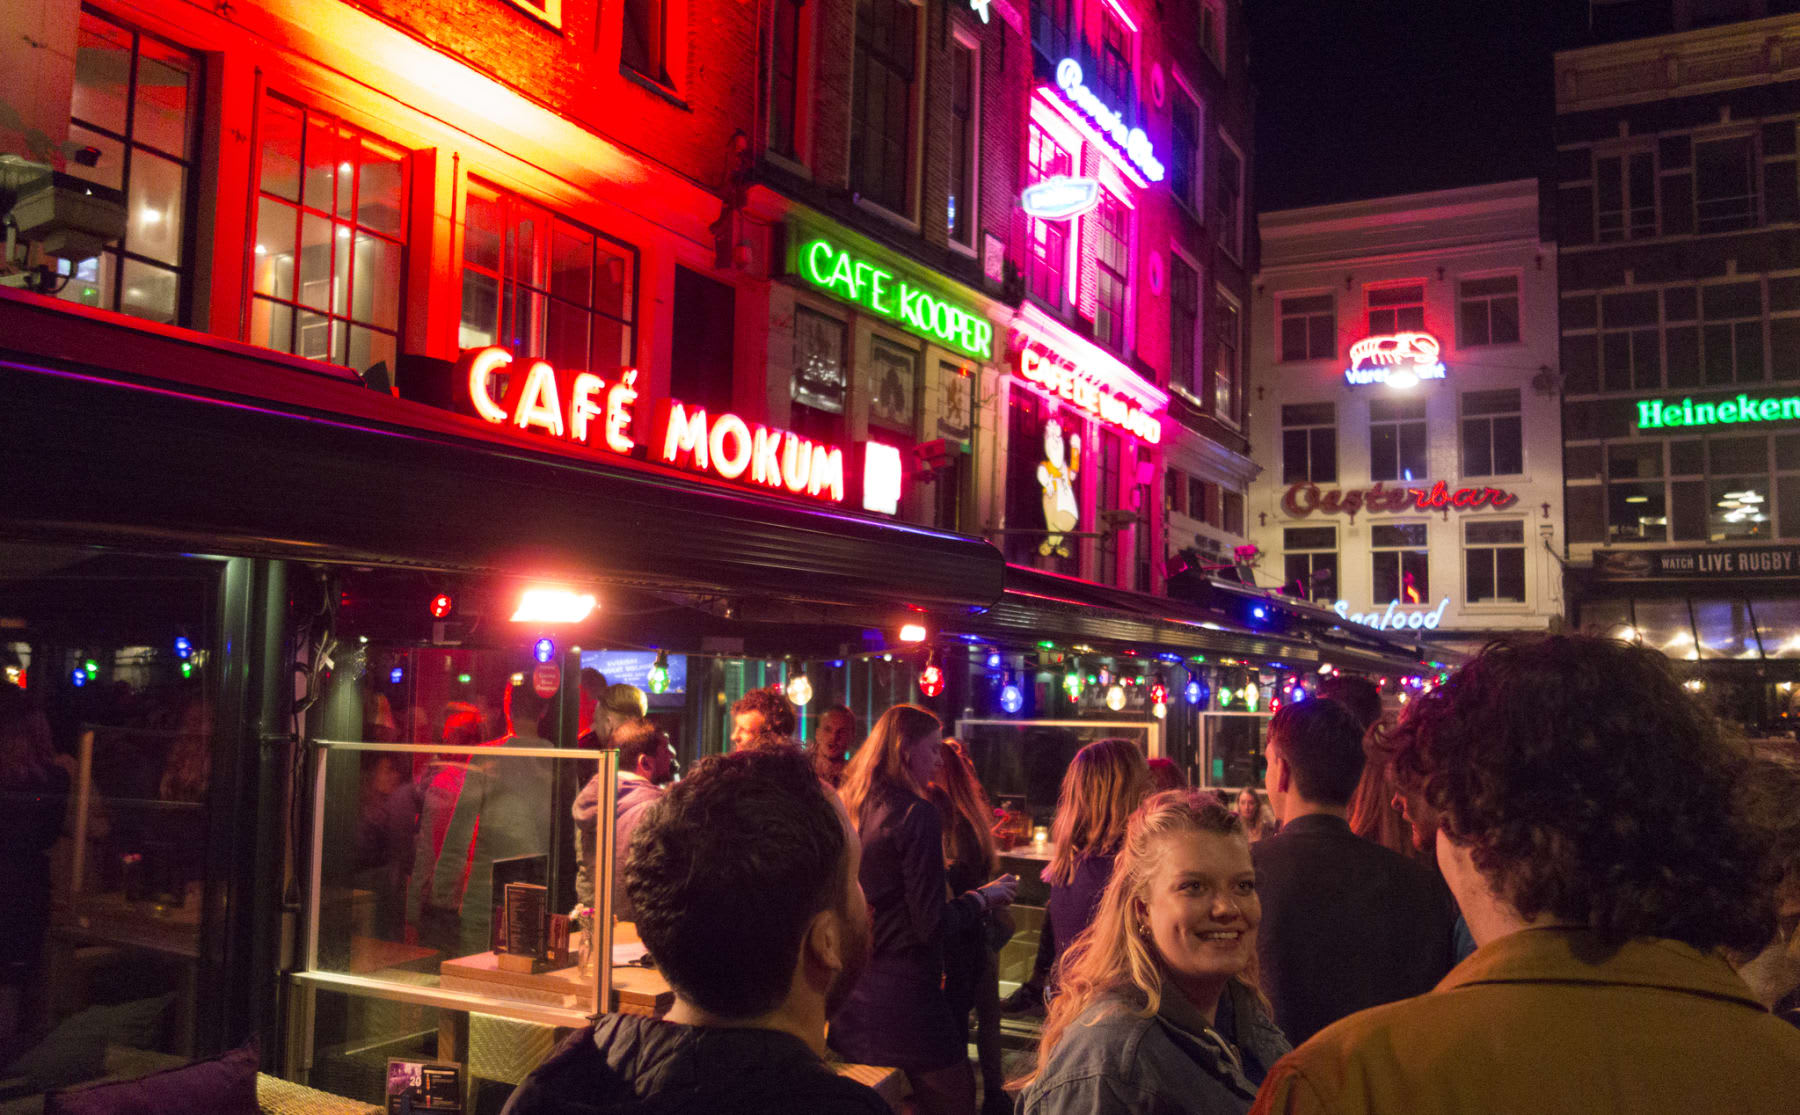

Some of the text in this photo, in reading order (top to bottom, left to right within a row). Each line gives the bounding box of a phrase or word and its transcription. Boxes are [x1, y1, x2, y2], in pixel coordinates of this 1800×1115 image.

[809, 240, 993, 359] CAFE KOOPER
[468, 347, 844, 502] CAFÉ MOKUM
[1636, 394, 1800, 429] Heineken
[1281, 480, 1517, 518] Oesterbar
[1660, 556, 1694, 569] WATCH
[1698, 553, 1733, 572] LIVE
[1738, 552, 1792, 572] RUGBY
[1333, 598, 1451, 631] Seafood
